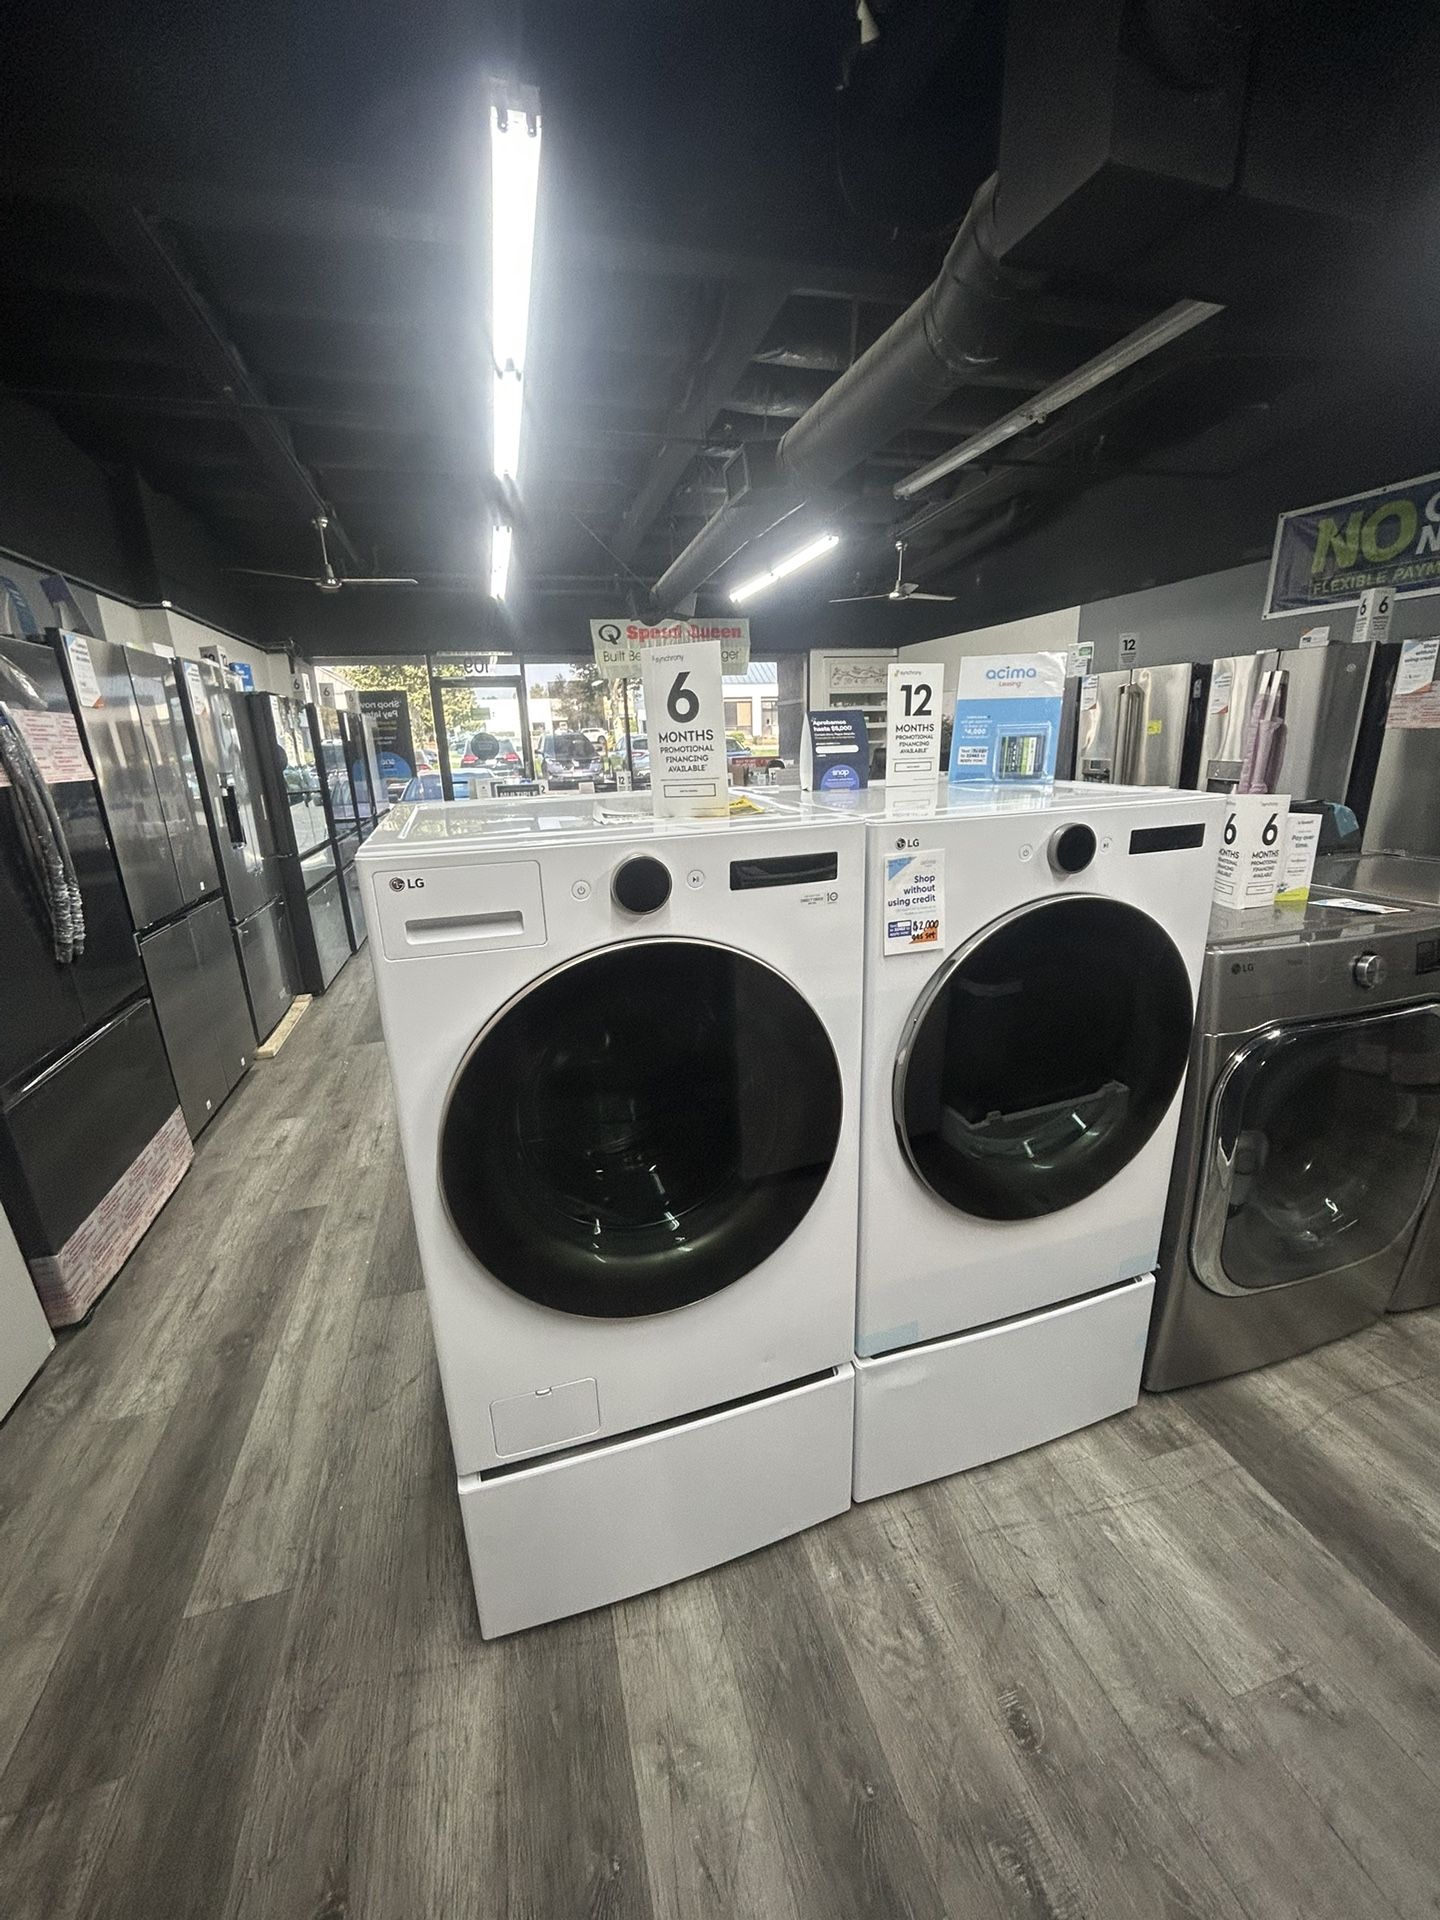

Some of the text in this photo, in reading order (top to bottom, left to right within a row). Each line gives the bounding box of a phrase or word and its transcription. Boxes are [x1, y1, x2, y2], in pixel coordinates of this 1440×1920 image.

[1311, 500, 1418, 575] NO
[1313, 571, 1387, 595] FLEXIBLE
[1360, 598, 1367, 615] 6
[1379, 596, 1389, 614] 6
[1123, 639, 1136, 651] 12
[603, 650, 625, 662] Built
[986, 666, 1037, 680] acima
[294, 679, 301, 690] 6
[323, 687, 331, 697] 6
[667, 671, 700, 724] 6
[900, 684, 932, 717] 12
[896, 724, 935, 733] MONTHS
[658, 729, 714, 744] MONTHS
[660, 744, 714, 754] PROMOTIONAL
[665, 754, 709, 764] FINANCING
[1224, 812, 1237, 845] 6
[1262, 812, 1279, 846] 6
[907, 839, 920, 848] LG
[1219, 848, 1240, 860] ONTHS
[1252, 849, 1280, 859] MONTHS
[407, 878, 425, 889] LG
[914, 875, 935, 884] Shop
[903, 884, 935, 895] without
[888, 894, 935, 907] using credit
